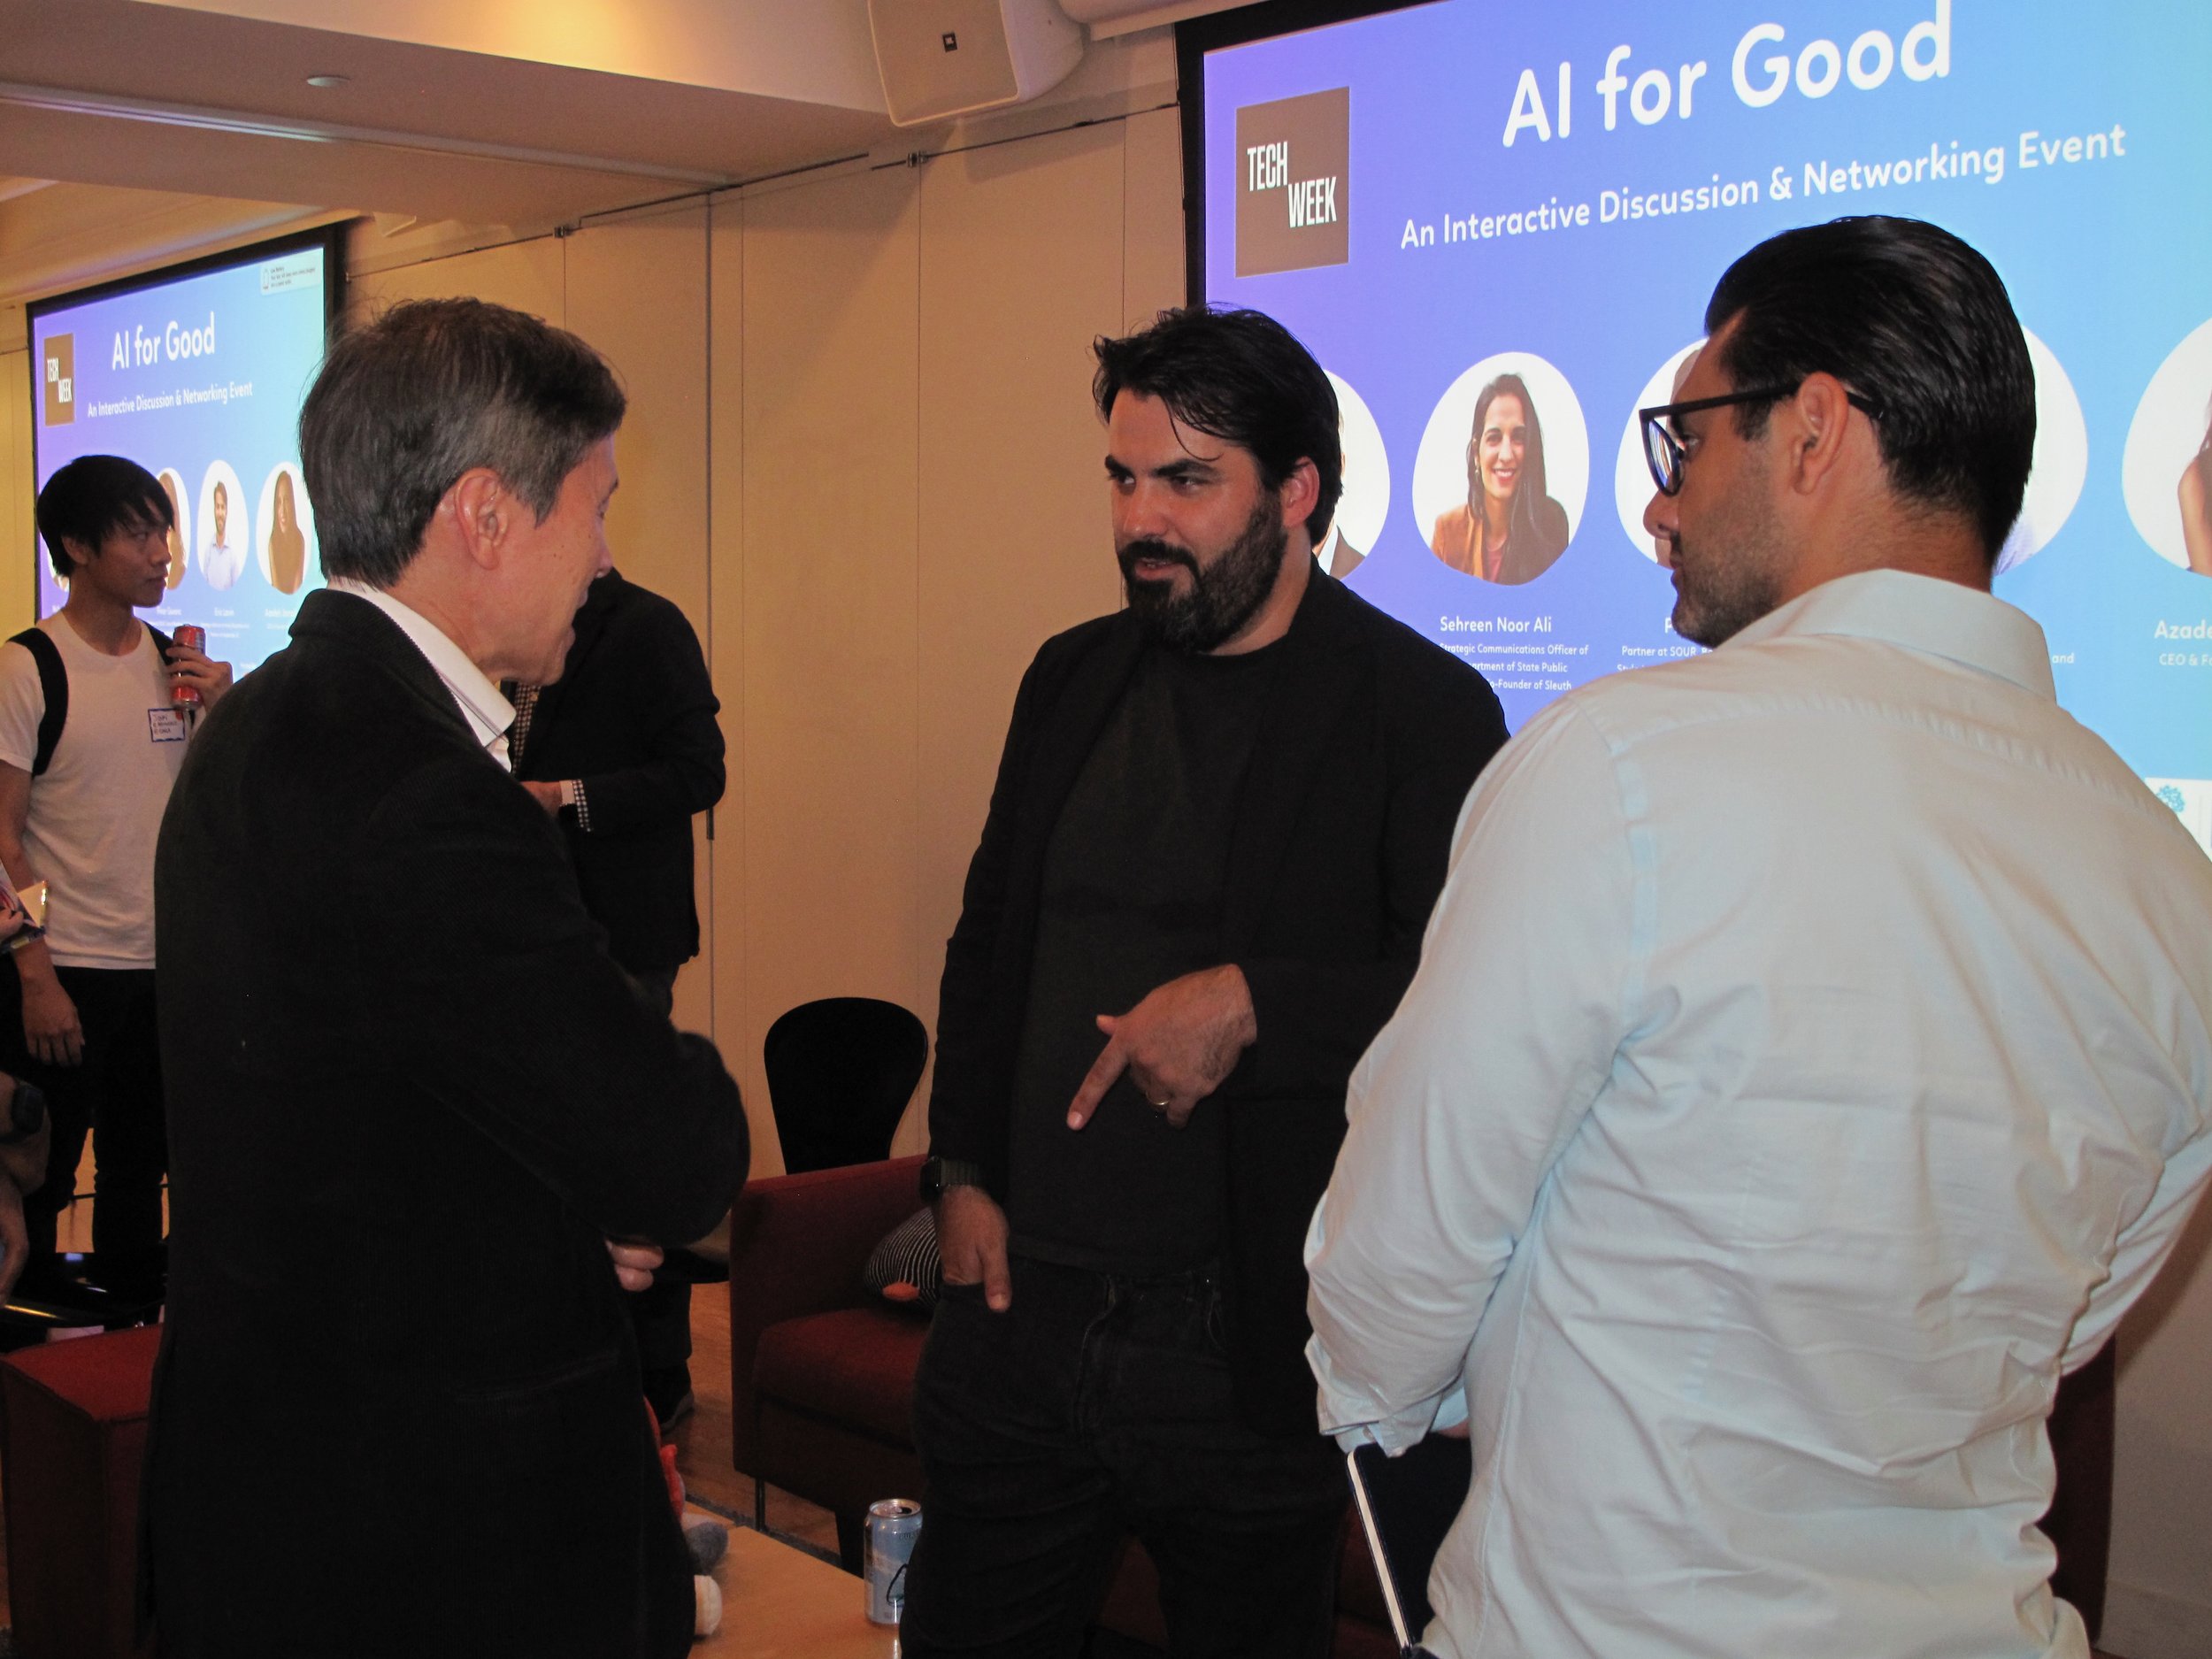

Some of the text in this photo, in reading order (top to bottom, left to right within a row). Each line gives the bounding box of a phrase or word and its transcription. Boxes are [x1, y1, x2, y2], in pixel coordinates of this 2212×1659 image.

[1502, 0, 1950, 148] AI for Good
[1247, 141, 1288, 192] TECH
[1401, 124, 2126, 250] An Interactive Discussion & Networking Event
[1288, 176, 1337, 228] WEEK
[112, 311, 216, 371] AI for Good
[47, 357, 59, 383] TECH
[58, 378, 73, 403] WEEK
[88, 381, 253, 418] An Interactive Discussion & Networking Event
[1440, 616, 1552, 633] Sehreen Noor Ali
[1477, 643, 1545, 655] Communications
[1547, 644, 1577, 655] Officer
[1578, 644, 1590, 655] of
[1622, 645, 1655, 657] Partner
[1657, 647, 1668, 657] at
[1670, 646, 1696, 657] SOUR
[2052, 652, 2075, 664] and
[2159, 653, 2185, 666] CEO
[1470, 661, 1568, 672] artment of State Public
[1486, 679, 1572, 690] o-Founder of Sleuth
